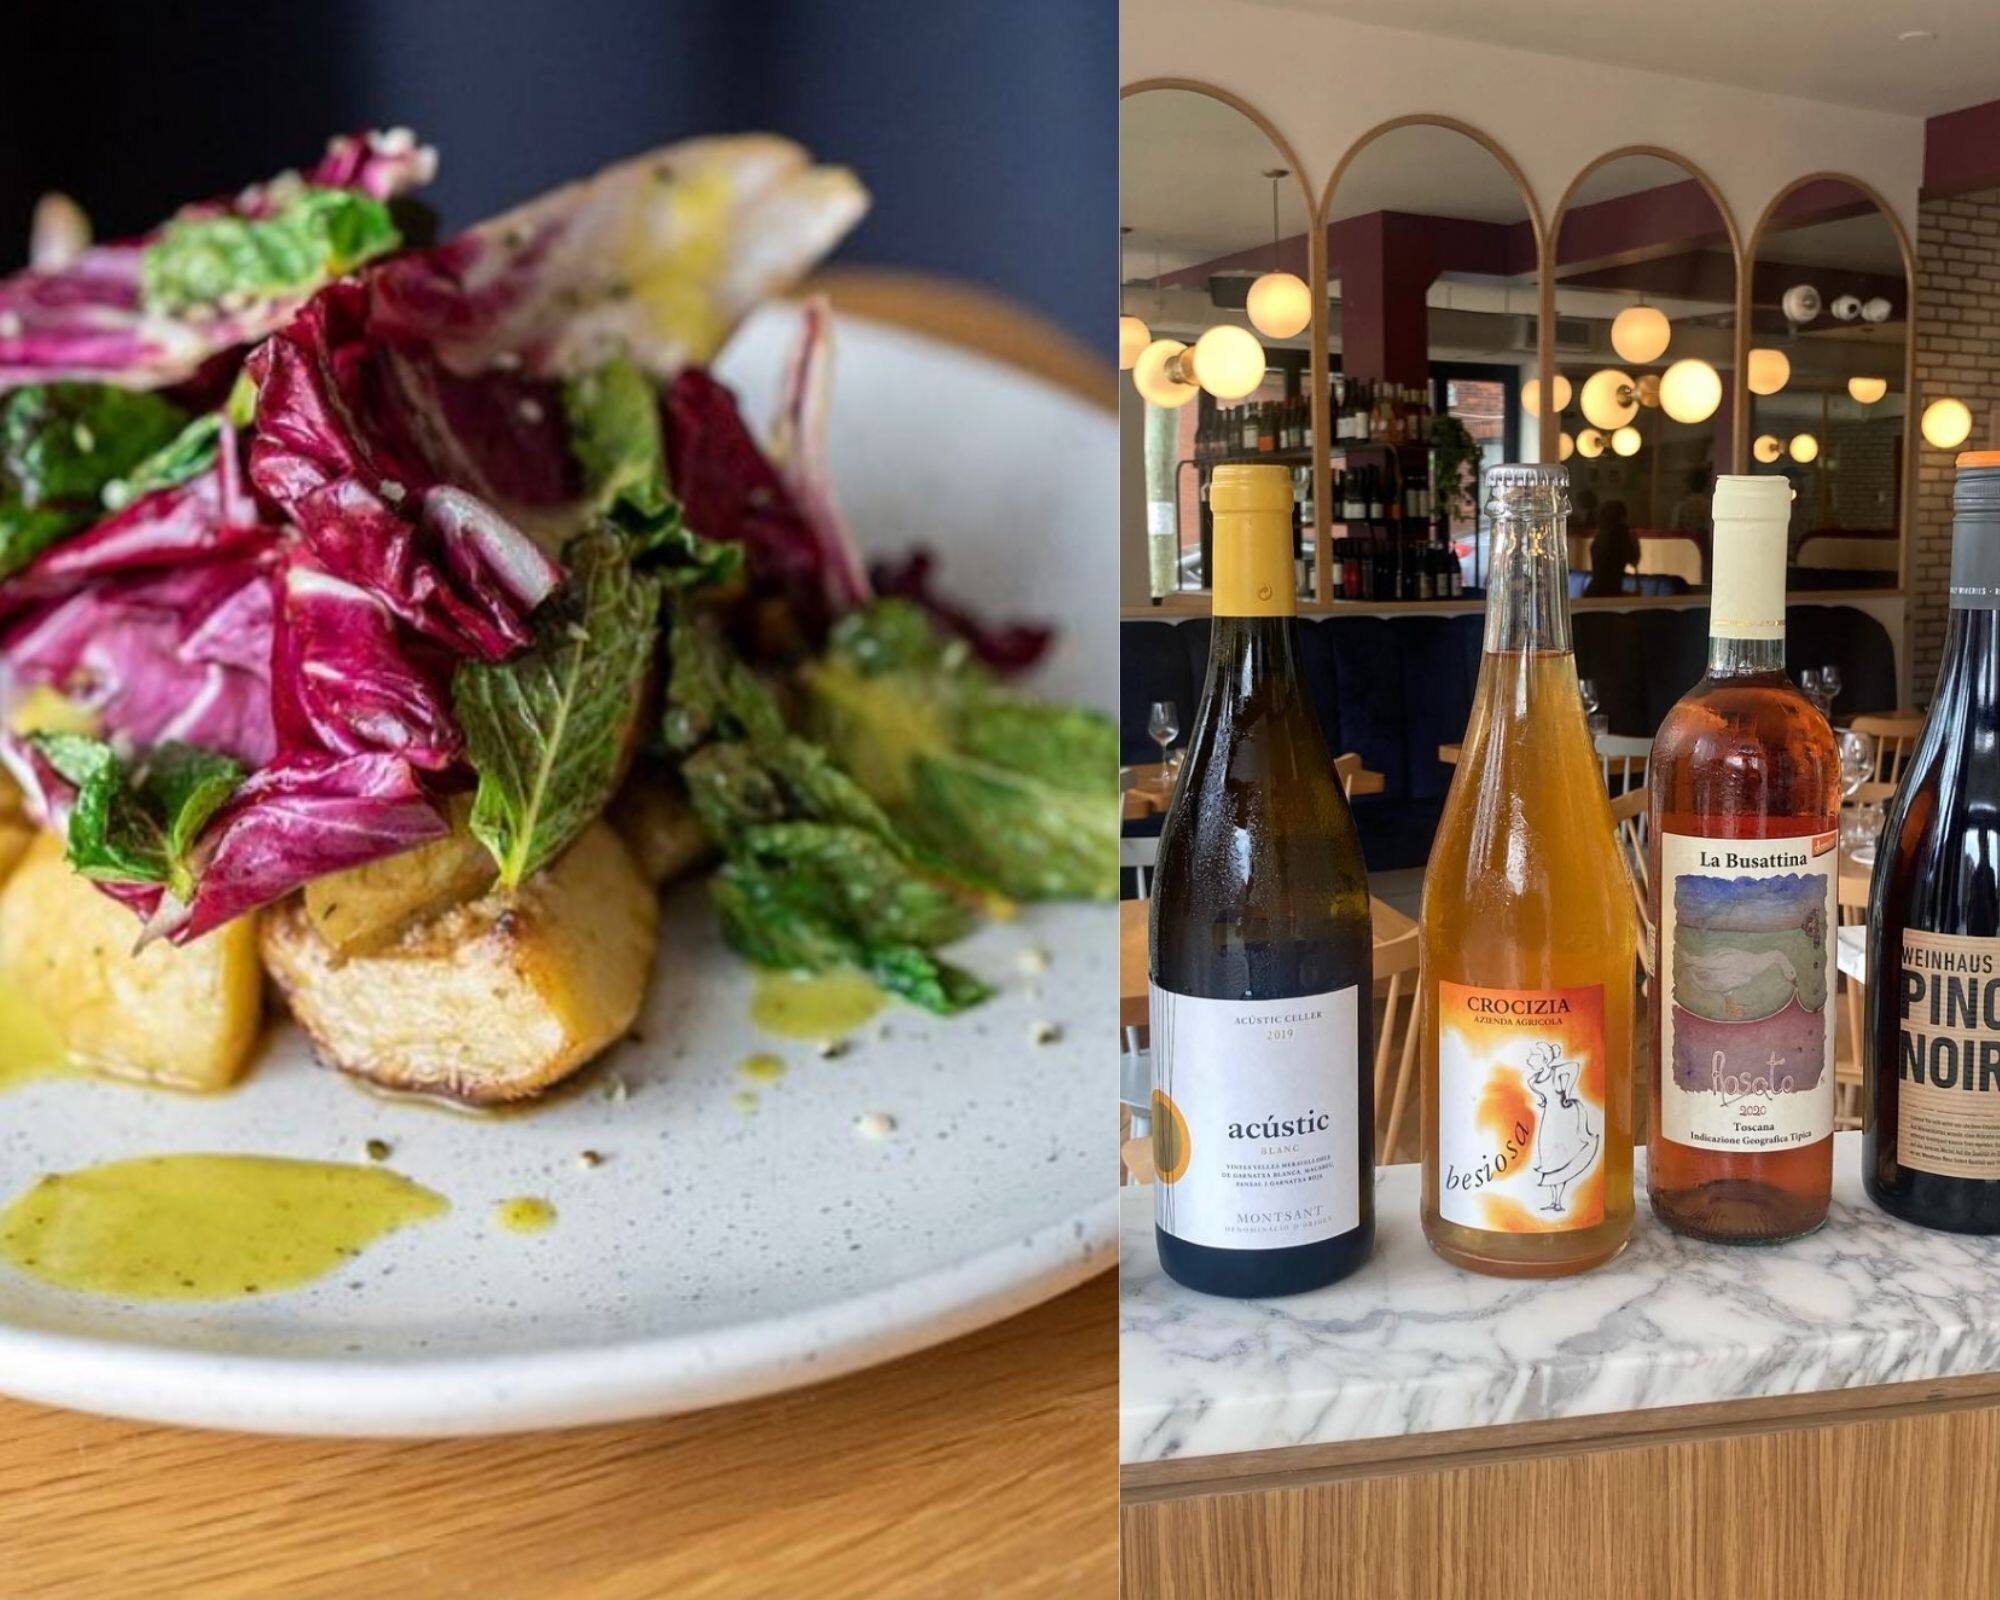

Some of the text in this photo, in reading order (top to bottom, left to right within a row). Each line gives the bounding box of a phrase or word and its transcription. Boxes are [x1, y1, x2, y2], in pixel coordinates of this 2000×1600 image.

[1700, 851, 1808, 868] La Busattina
[1901, 945, 1993, 974] WEINHAUS
[1467, 996, 1571, 1015] CROCIZIA
[1235, 1010, 1322, 1024] ACÚSTIC CELLER
[1473, 1015, 1563, 1026] AZIENDA AGRICOLA
[1266, 1028, 1294, 1041] 2019
[1899, 1029, 2000, 1092] NOIR
[1739, 1105, 1767, 1117] 2020
[1228, 1109, 1330, 1140] acústic
[1733, 1122, 1775, 1132] Toscana
[1690, 1130, 1812, 1146] Indicazione Geografica Tipica
[1260, 1144, 1300, 1155] BLANC
[1446, 1120, 1531, 1191] besiosa
[1237, 1204, 1325, 1223] MONTSANT
